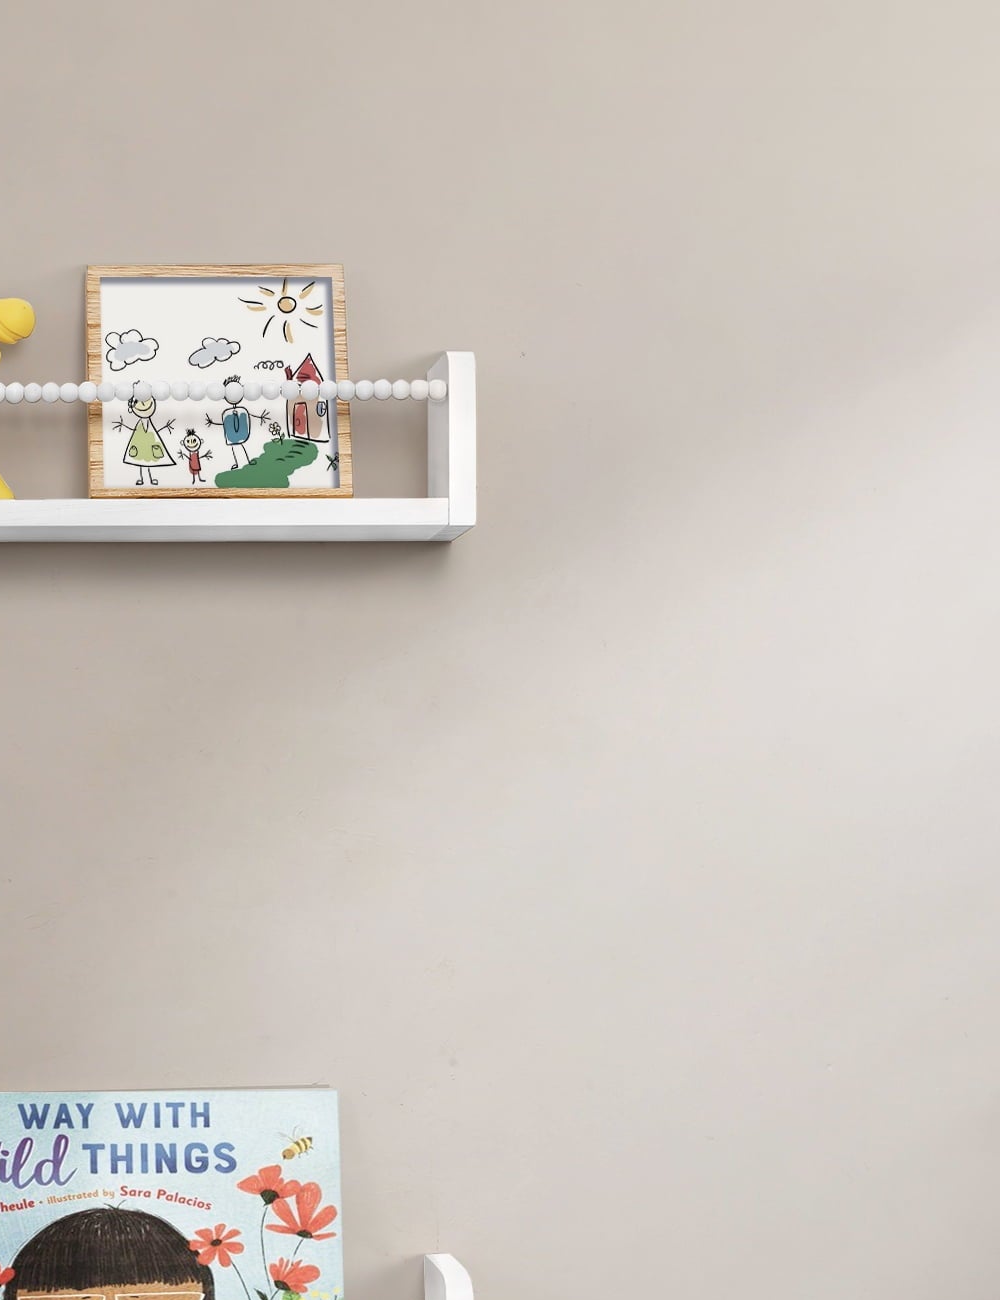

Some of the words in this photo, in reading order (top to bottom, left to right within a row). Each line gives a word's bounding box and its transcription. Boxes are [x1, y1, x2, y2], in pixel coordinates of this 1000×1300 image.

[17, 1103, 94, 1130] WAY
[114, 1102, 211, 1129] WITH
[82, 1142, 237, 1174] THINGS
[46, 1189, 99, 1205] illustrated
[102, 1189, 115, 1199] by
[119, 1185, 151, 1198] Sara
[156, 1189, 212, 1211] Palacios
